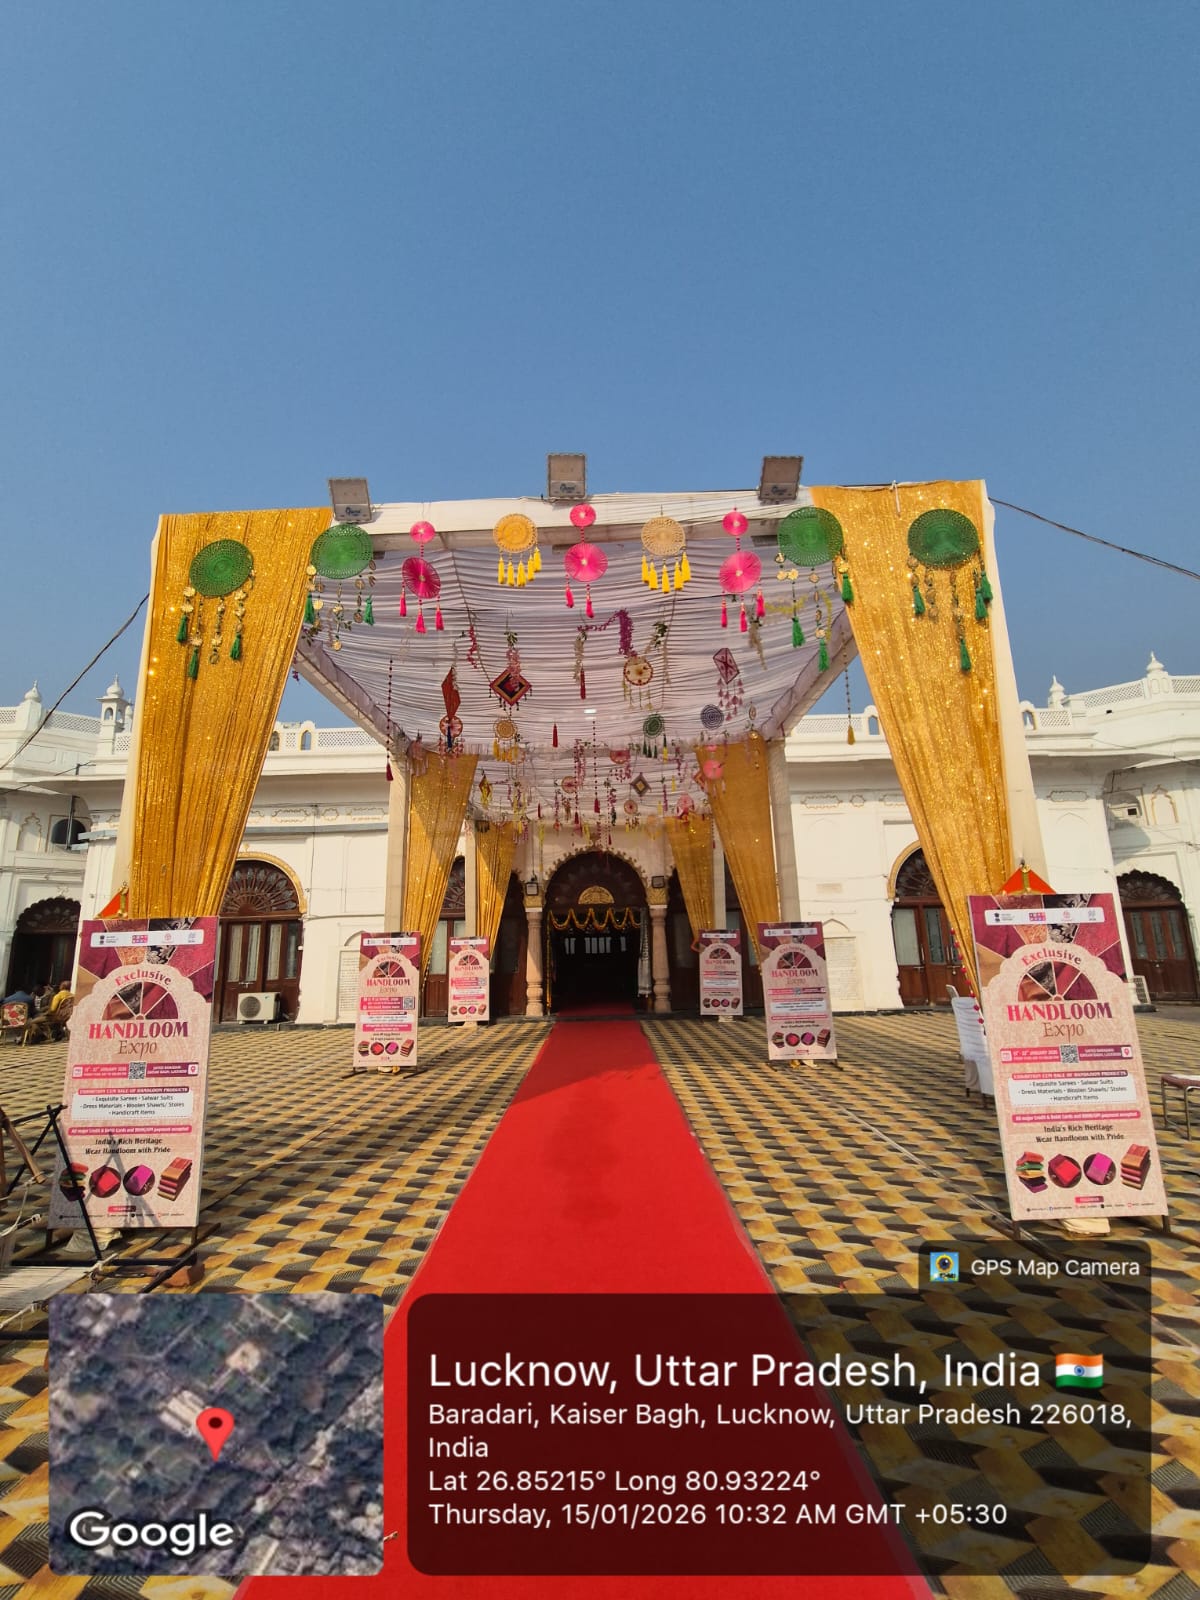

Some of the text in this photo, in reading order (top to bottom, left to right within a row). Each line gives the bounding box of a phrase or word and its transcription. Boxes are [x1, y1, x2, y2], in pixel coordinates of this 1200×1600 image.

[1021, 948, 1082, 966] Exclusive
[115, 969, 172, 986] Exclusive
[771, 968, 818, 978] HANDLOOM
[366, 978, 410, 986] HANDLOOM
[1007, 1002, 1112, 1021] HANDLOOM
[88, 1022, 188, 1039] HANDLOOM
[1043, 1022, 1084, 1042] Expo
[118, 1040, 158, 1058] Expo
